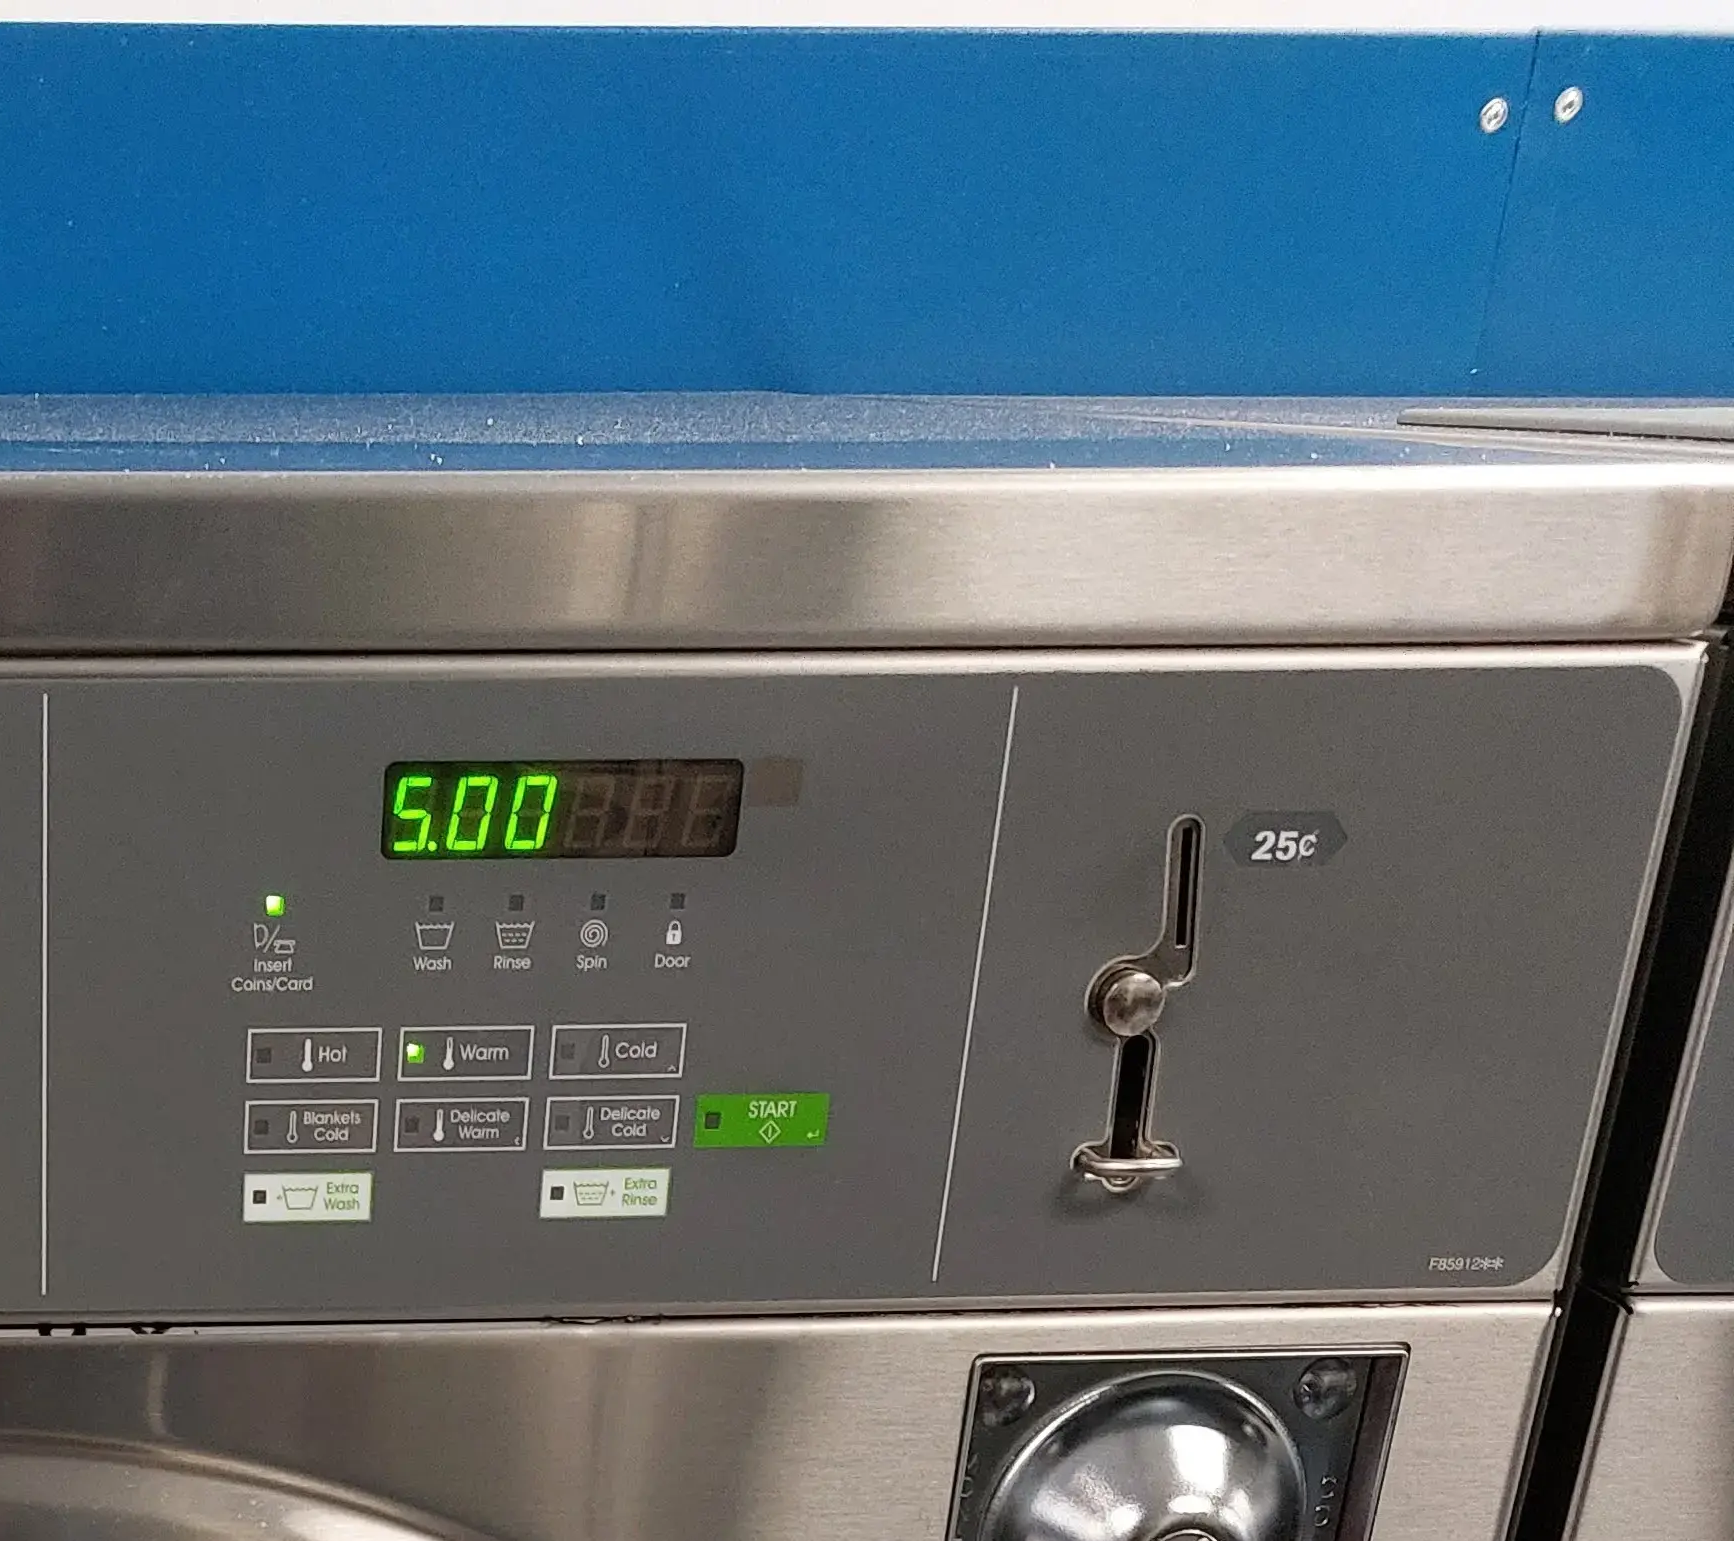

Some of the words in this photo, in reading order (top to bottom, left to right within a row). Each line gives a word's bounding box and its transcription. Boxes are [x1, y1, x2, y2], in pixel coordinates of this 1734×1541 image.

[392, 774, 558, 853] 5.00
[1251, 829, 1319, 861] 25¢
[254, 958, 292, 972] Insert
[413, 957, 451, 970] Wash
[494, 956, 531, 969] Rinse
[577, 955, 607, 971] Spin
[655, 954, 690, 968] Door
[232, 977, 313, 991] Coins/Card
[319, 1046, 347, 1062] Hot
[460, 1044, 508, 1060] Warm
[616, 1042, 657, 1058] Cold
[451, 1109, 510, 1124] Delicate
[601, 1106, 660, 1122] Delicate
[749, 1101, 797, 1118] START
[304, 1111, 361, 1126] Blankets
[314, 1128, 348, 1141] Cold
[456, 1121, 499, 1139] Warm
[612, 1119, 649, 1136] Cold
[324, 1182, 359, 1199] Extra
[623, 1178, 657, 1195] Extra
[324, 1198, 360, 1210] Wash
[622, 1194, 657, 1205] Rinse
